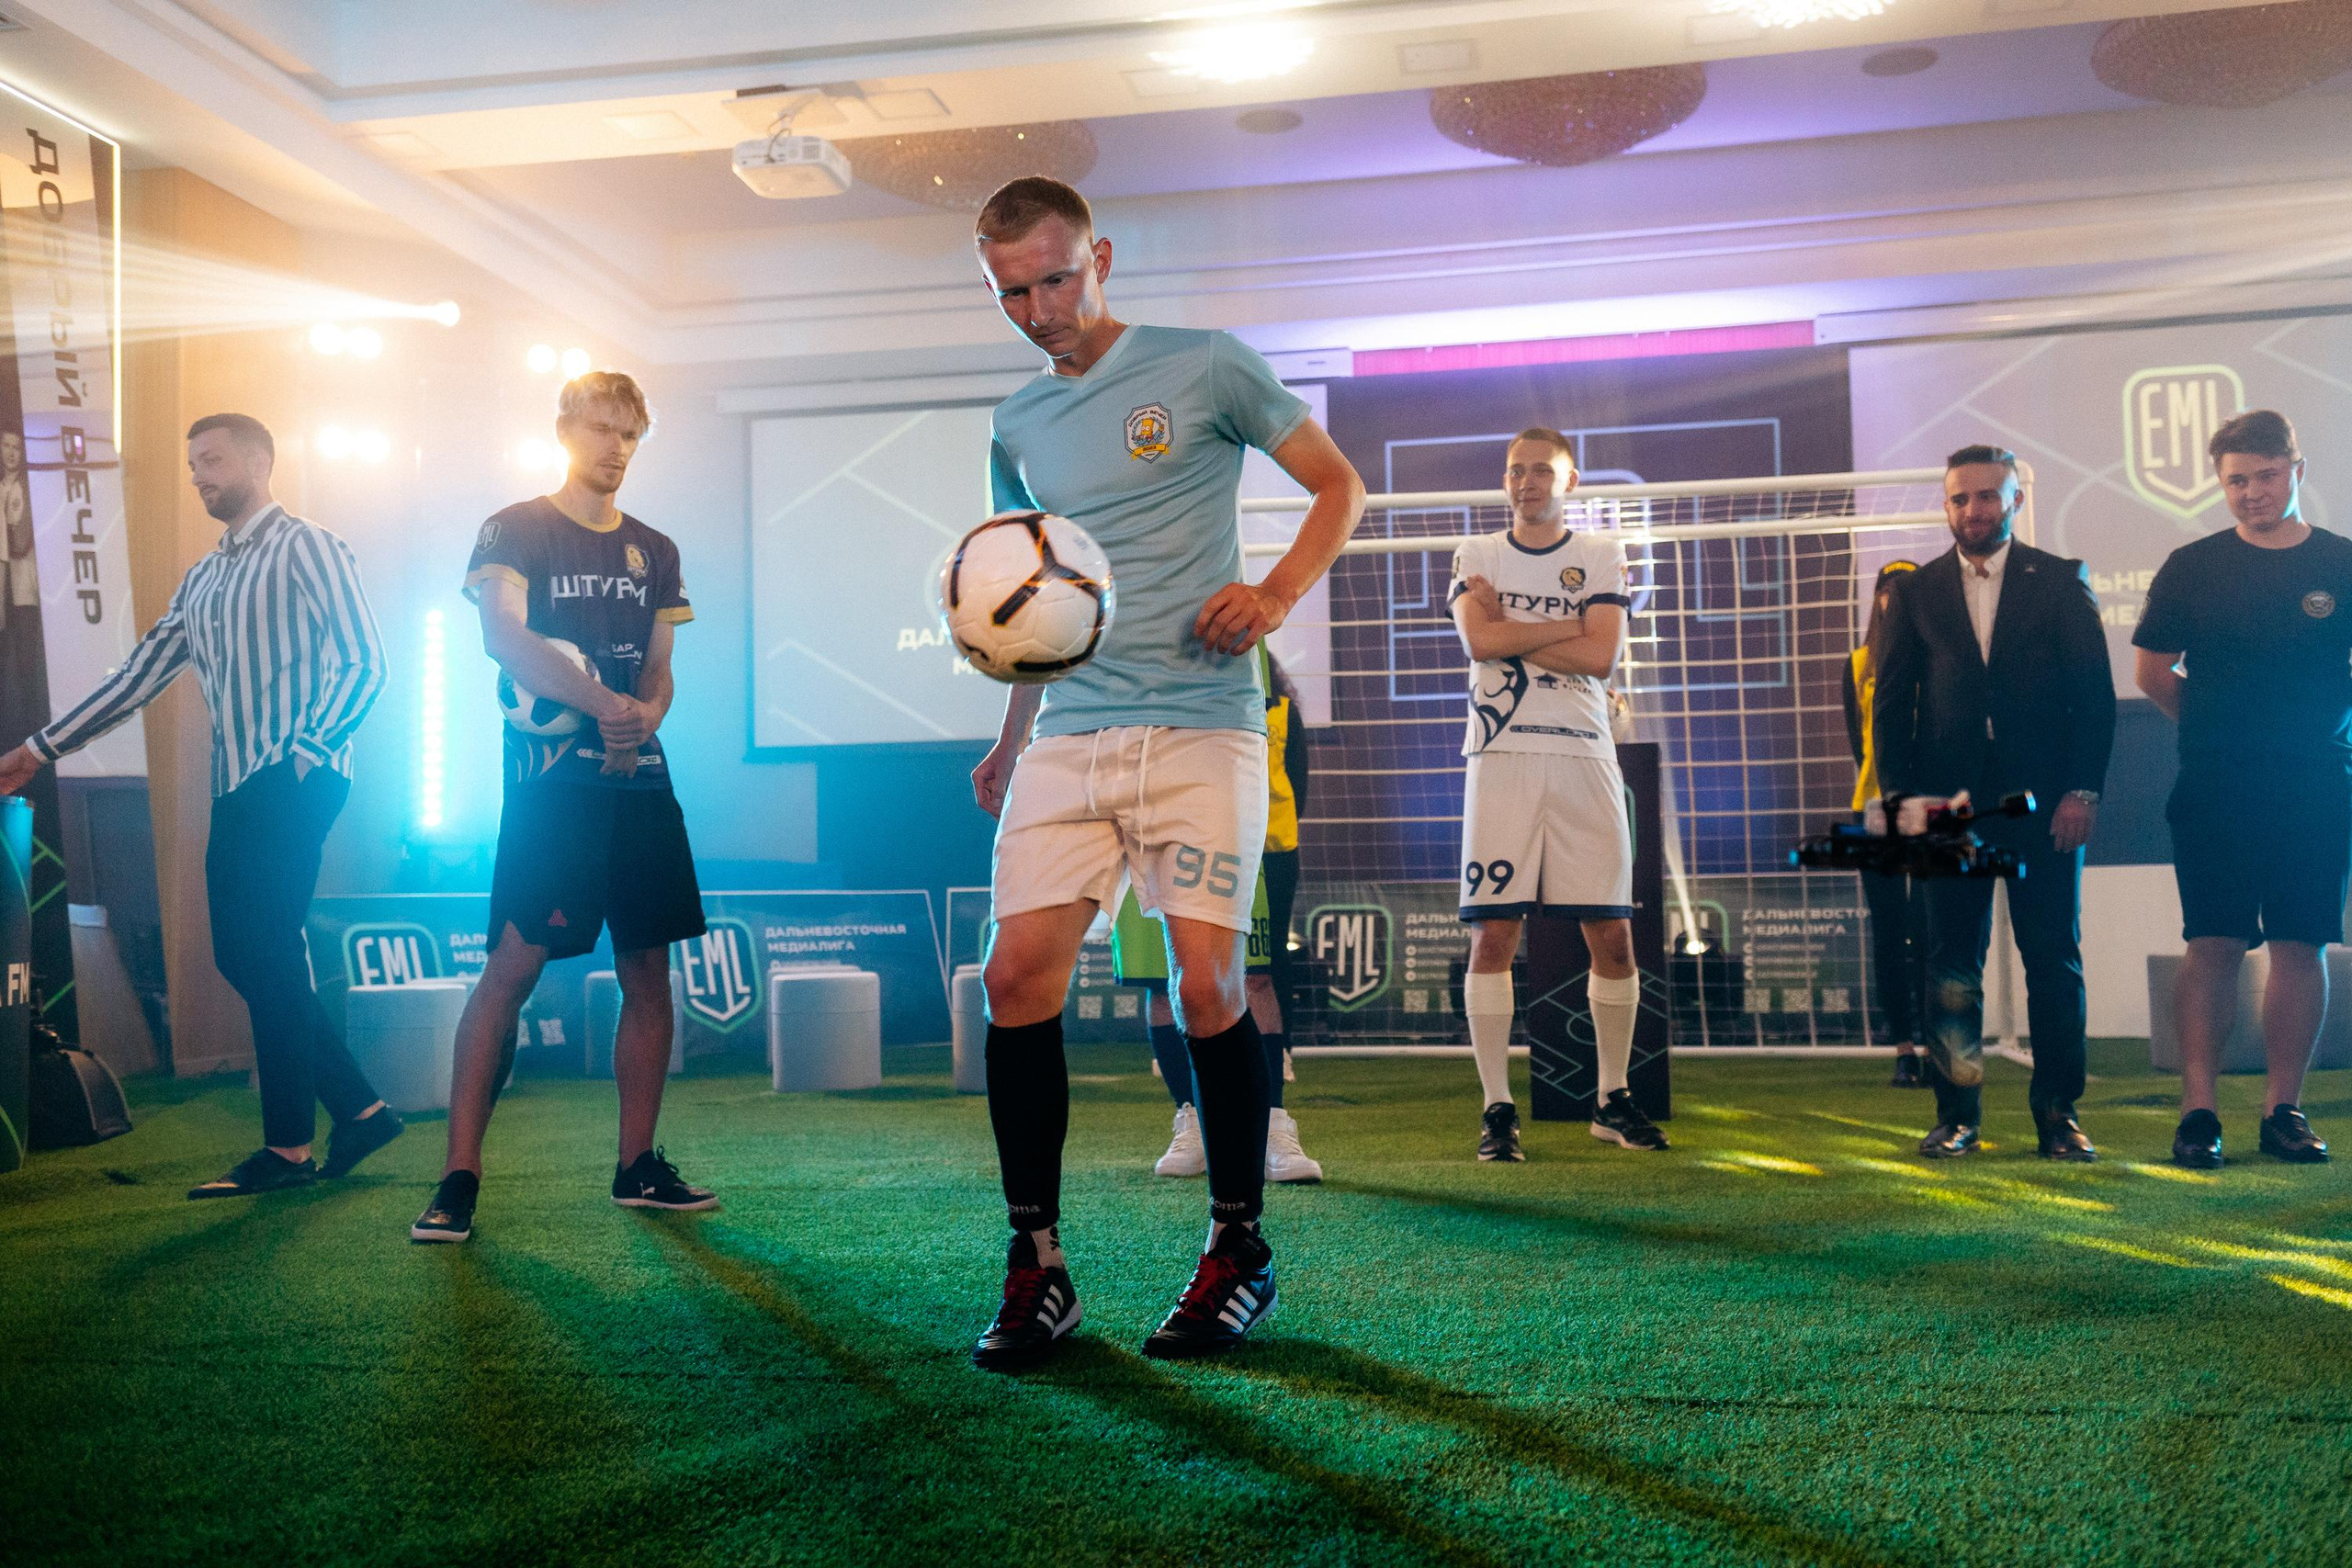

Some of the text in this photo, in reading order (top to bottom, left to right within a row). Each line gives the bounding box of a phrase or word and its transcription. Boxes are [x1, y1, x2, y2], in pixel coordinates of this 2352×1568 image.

[60, 425, 102, 625] ВЕЧЕР
[550, 573, 648, 609] ШТУРМ
[1172, 845, 1242, 898] 95
[1465, 860, 1515, 897] 99
[1405, 913, 1460, 925] ДАЛЬН
[764, 923, 907, 939] ДАЛЬНЕВОСТОЧНАЯ
[1405, 927, 1472, 941] МЕДИАЛ
[766, 940, 855, 953] МЕДИАЛИГА
[1006, 1202, 1042, 1214] oma
